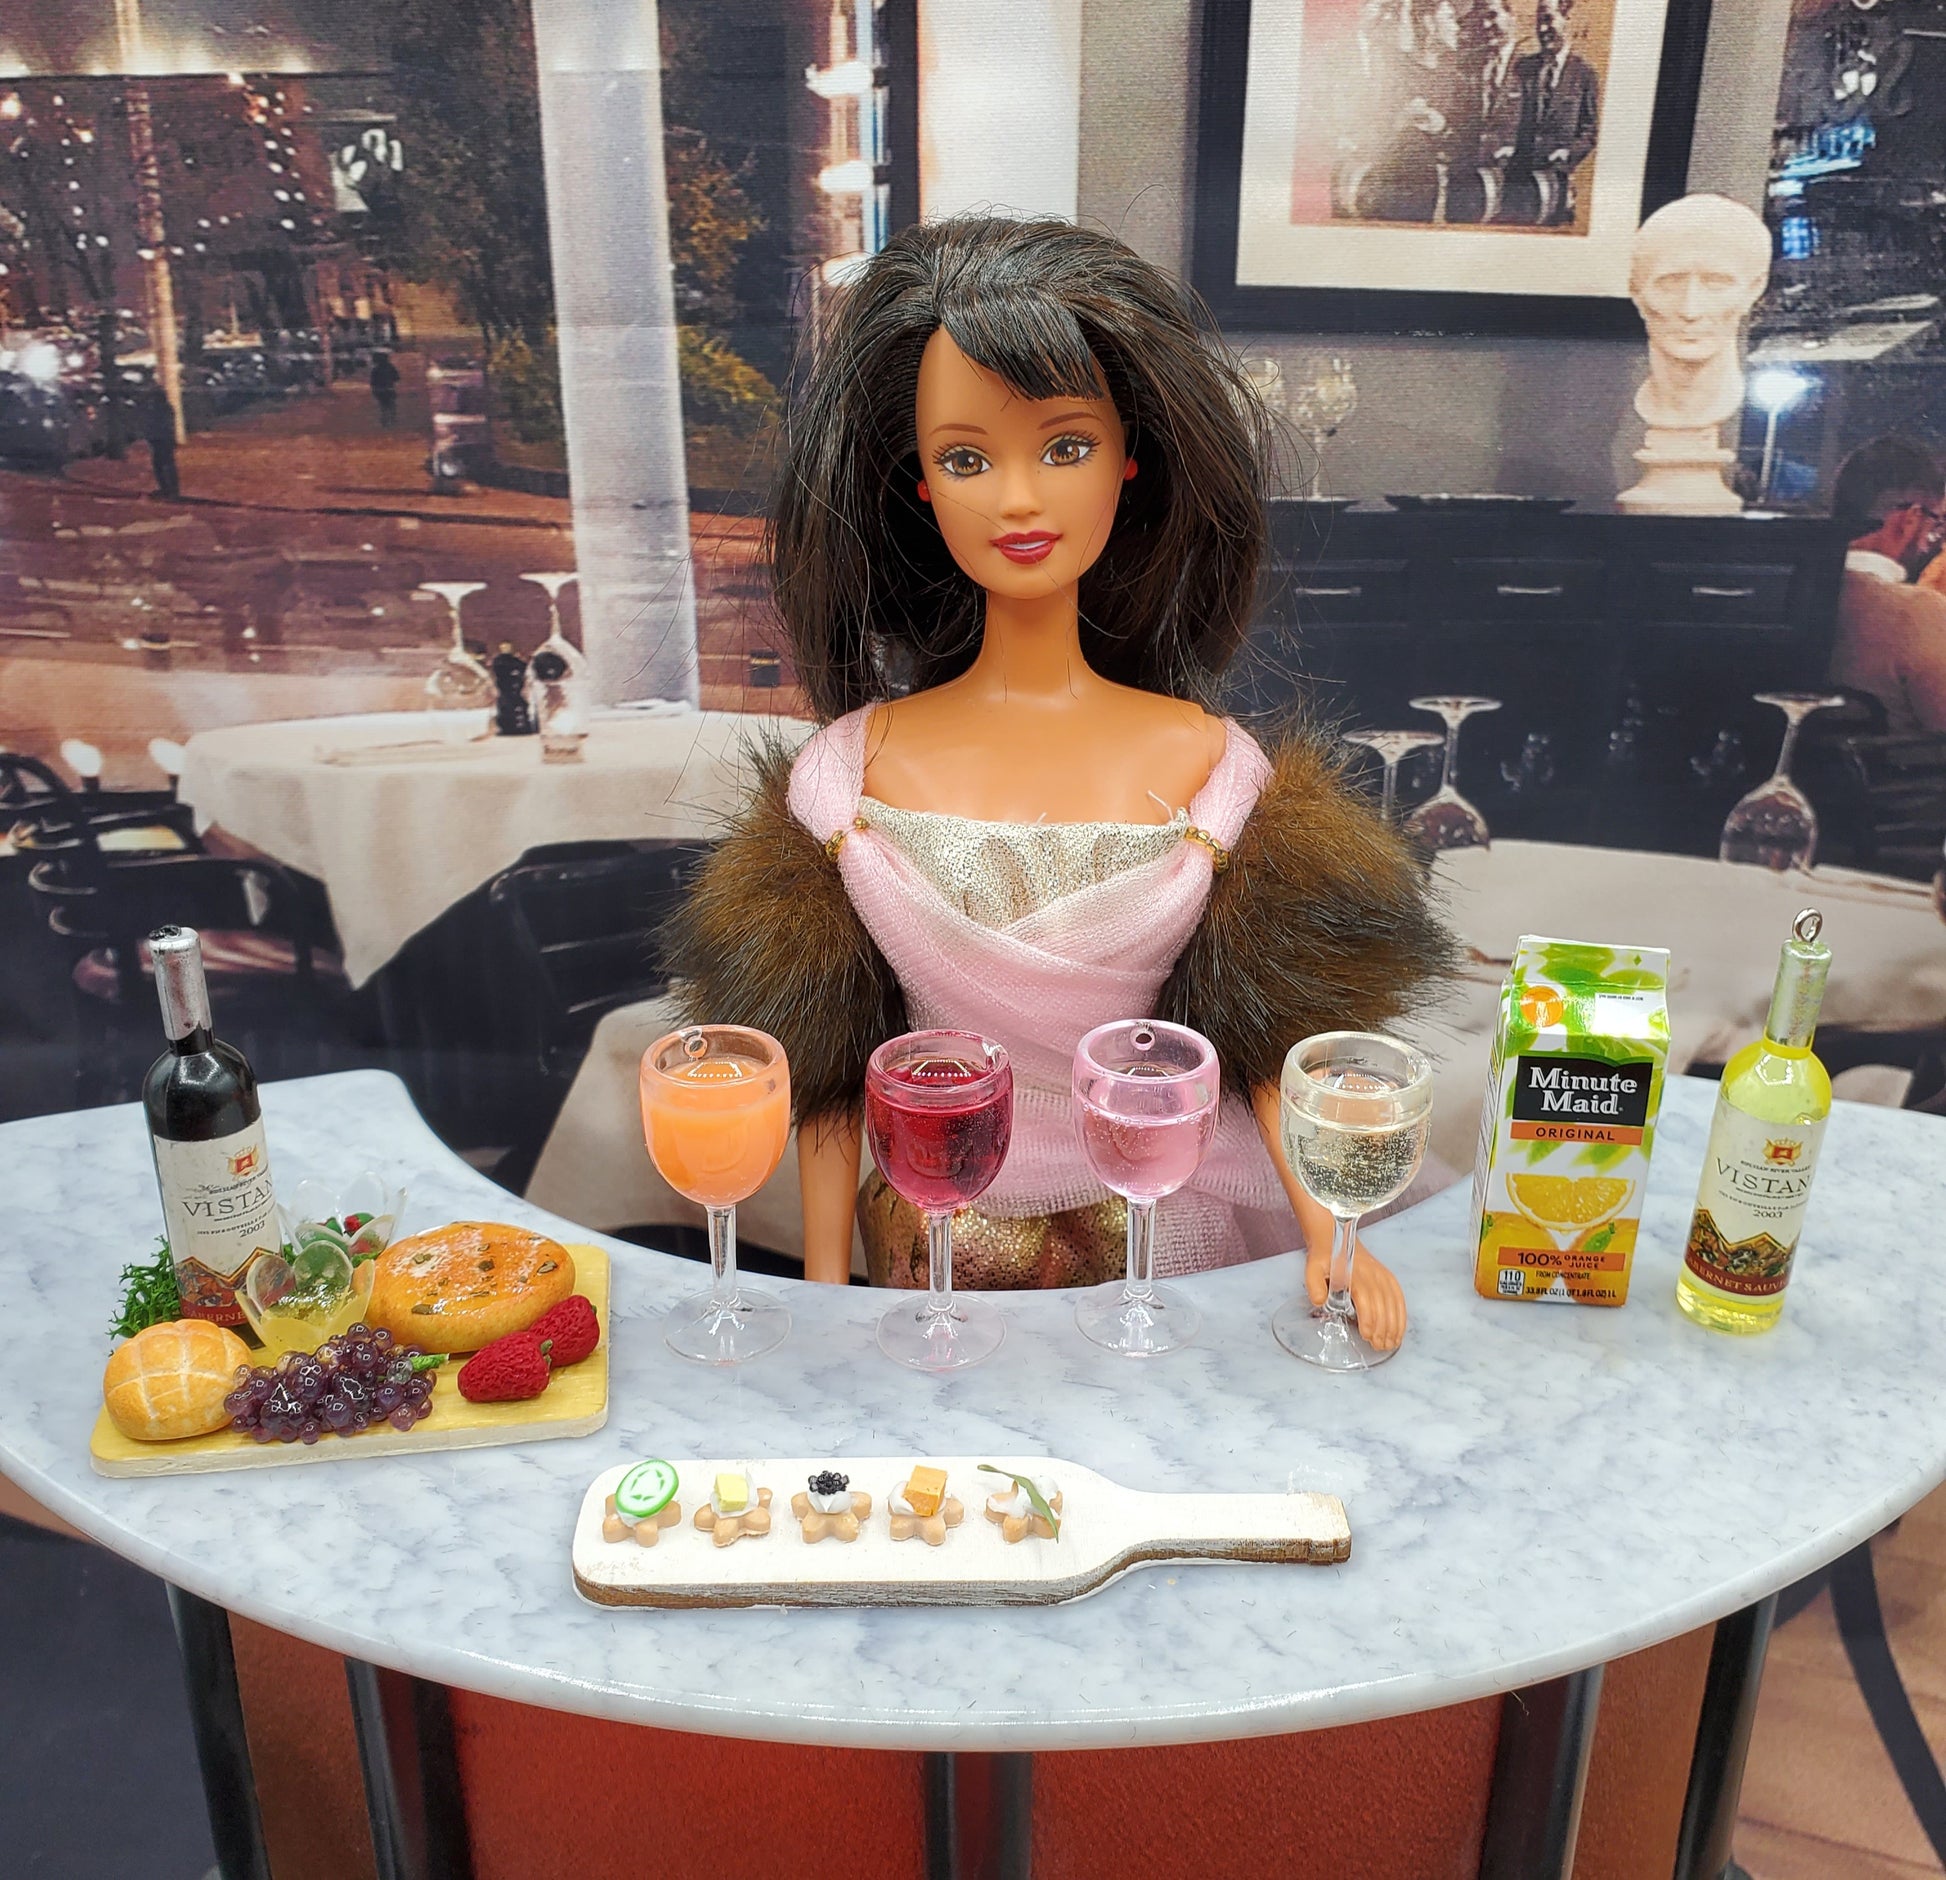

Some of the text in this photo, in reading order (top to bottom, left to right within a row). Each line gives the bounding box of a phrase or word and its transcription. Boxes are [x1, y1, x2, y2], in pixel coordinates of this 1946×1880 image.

[1528, 1066, 1637, 1094] Minute
[1541, 1090, 1619, 1115] Maid
[1536, 1127, 1615, 1141] ORIGINAL
[1753, 1209, 1783, 1218] 2003
[239, 1220, 265, 1238] 2003
[1518, 1252, 1605, 1266] 100% ORANGE
[1569, 1261, 1599, 1269] JUICE
[1504, 1270, 1521, 1281] 110
[1535, 1270, 1551, 1279] FROM
[182, 1306, 247, 1322] CABERNE
